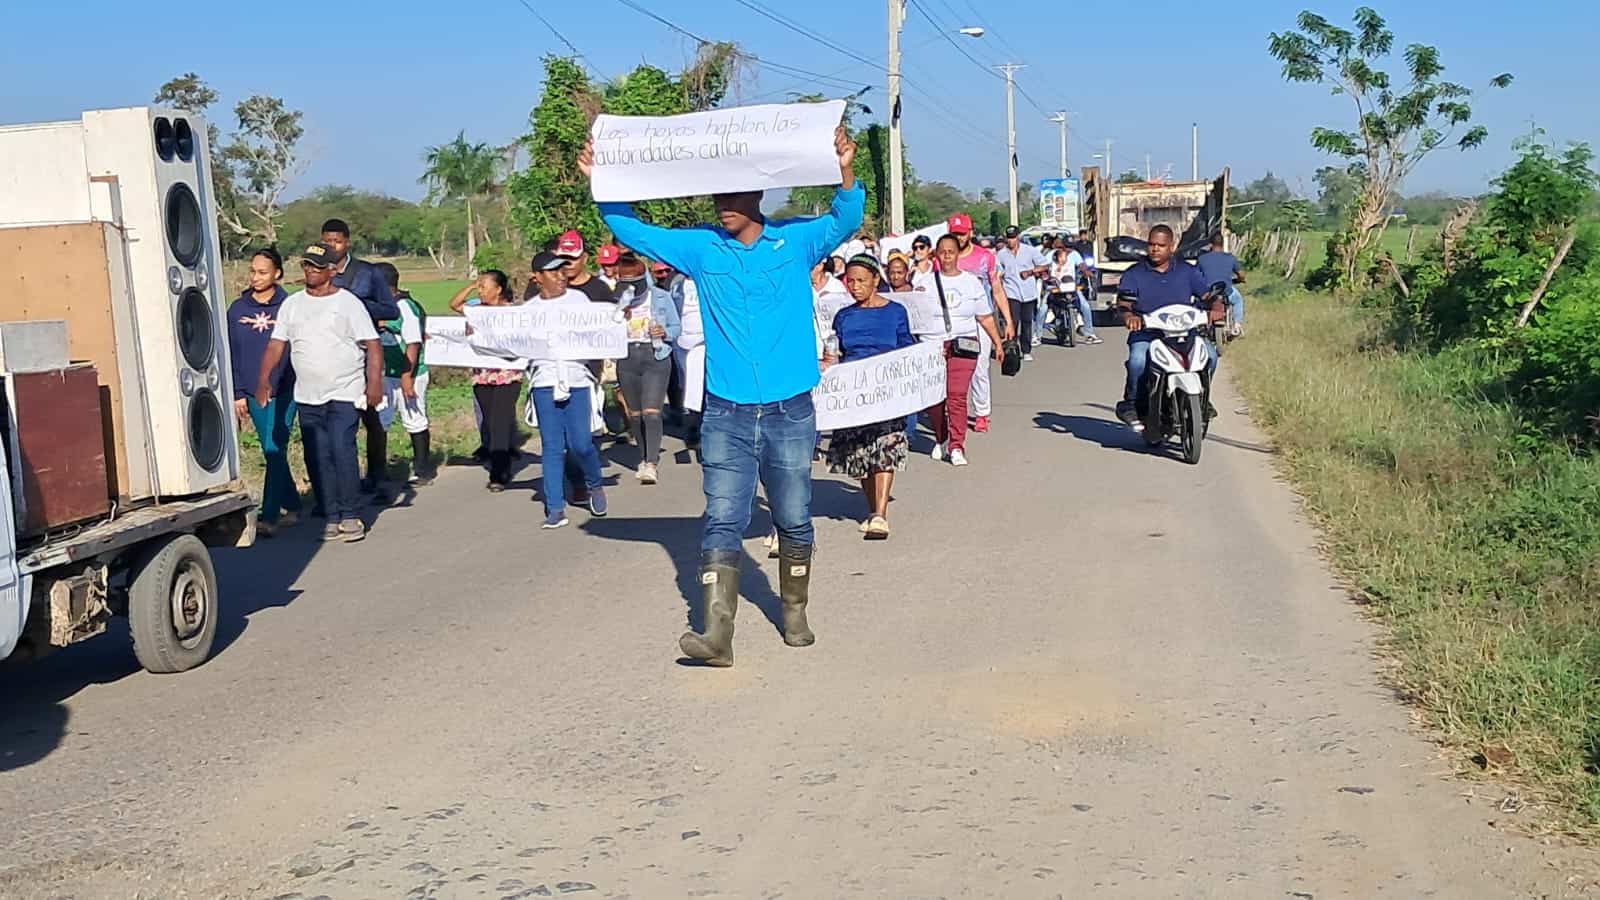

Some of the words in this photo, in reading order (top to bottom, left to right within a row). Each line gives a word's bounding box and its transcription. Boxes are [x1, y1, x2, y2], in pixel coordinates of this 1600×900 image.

[595, 136, 695, 166] autoridades
[698, 134, 749, 160] callan
[853, 366, 868, 390] LA
